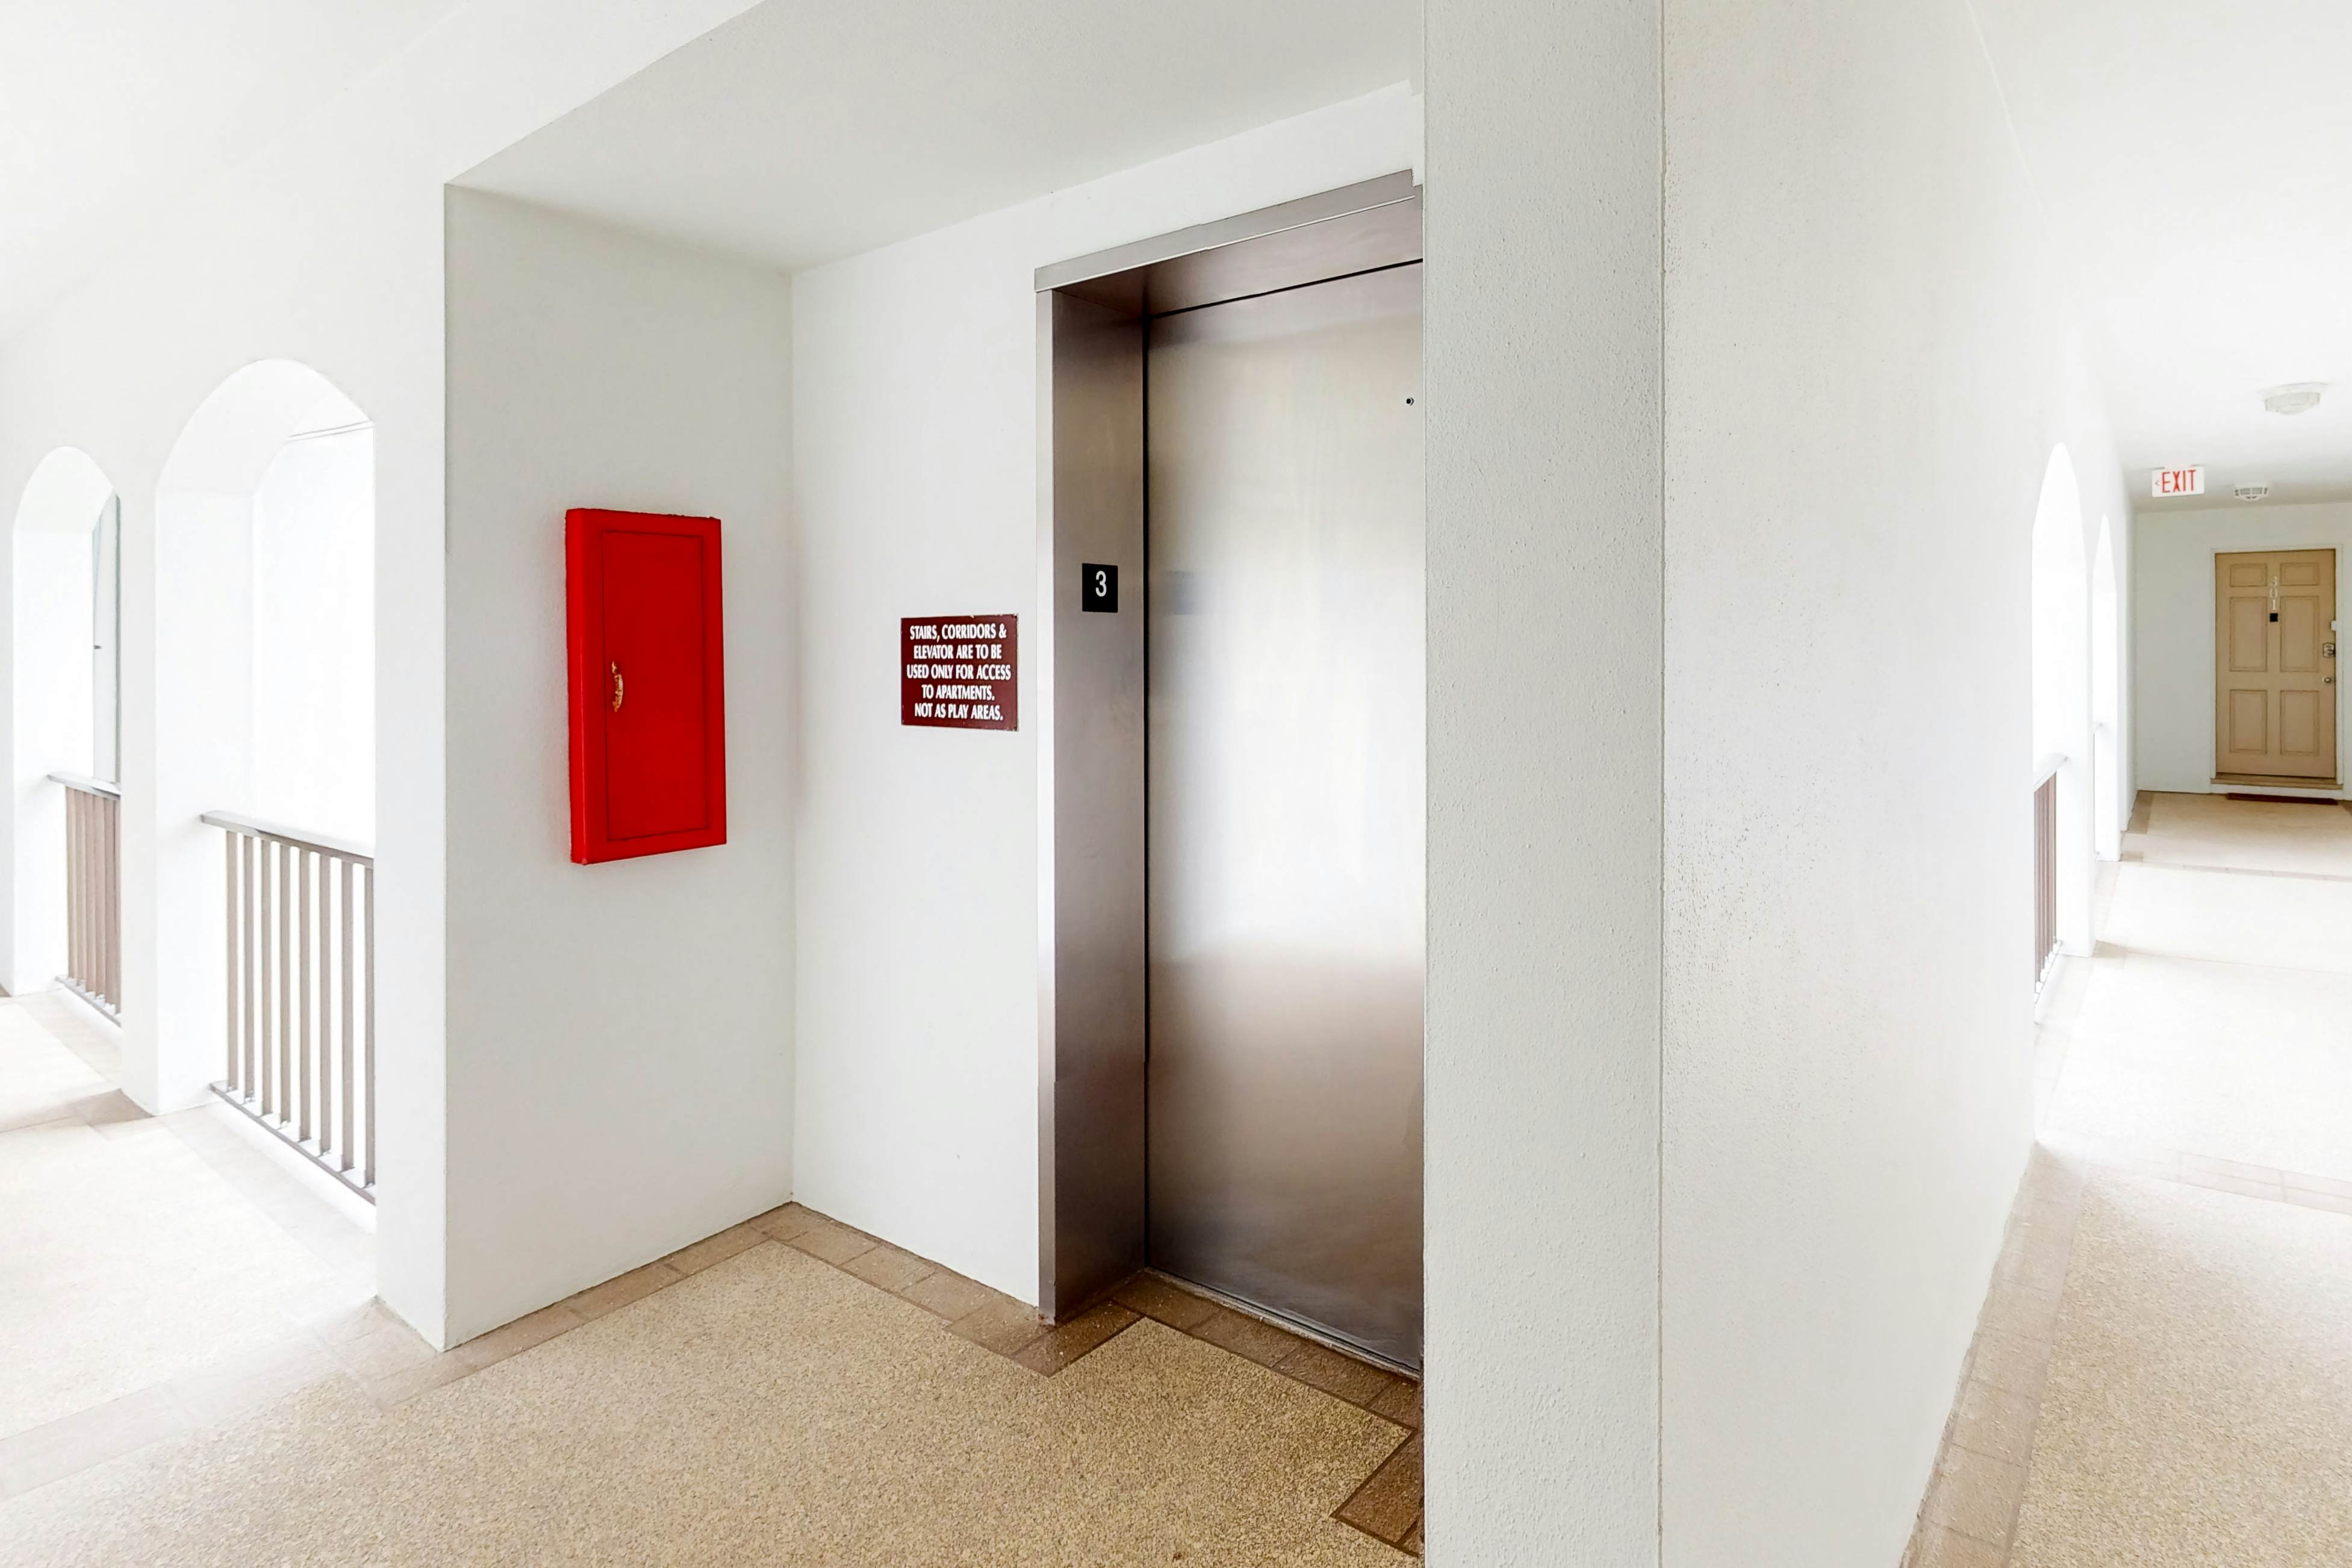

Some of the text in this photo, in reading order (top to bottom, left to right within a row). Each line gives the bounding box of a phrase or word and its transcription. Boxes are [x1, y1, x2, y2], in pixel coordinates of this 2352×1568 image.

[2162, 470, 2196, 493] EXIT
[1095, 570, 1107, 597] 3
[910, 624, 1006, 642] STAIRS, CORRIDORS &
[913, 644, 1002, 659] ELEVATOR ARE TO BE
[907, 665, 1011, 680] USED ONLY FOR ACCESS
[922, 685, 995, 700] TO APARTMENTS.
[915, 703, 1003, 720] NOT AS PLAY AREAS.
